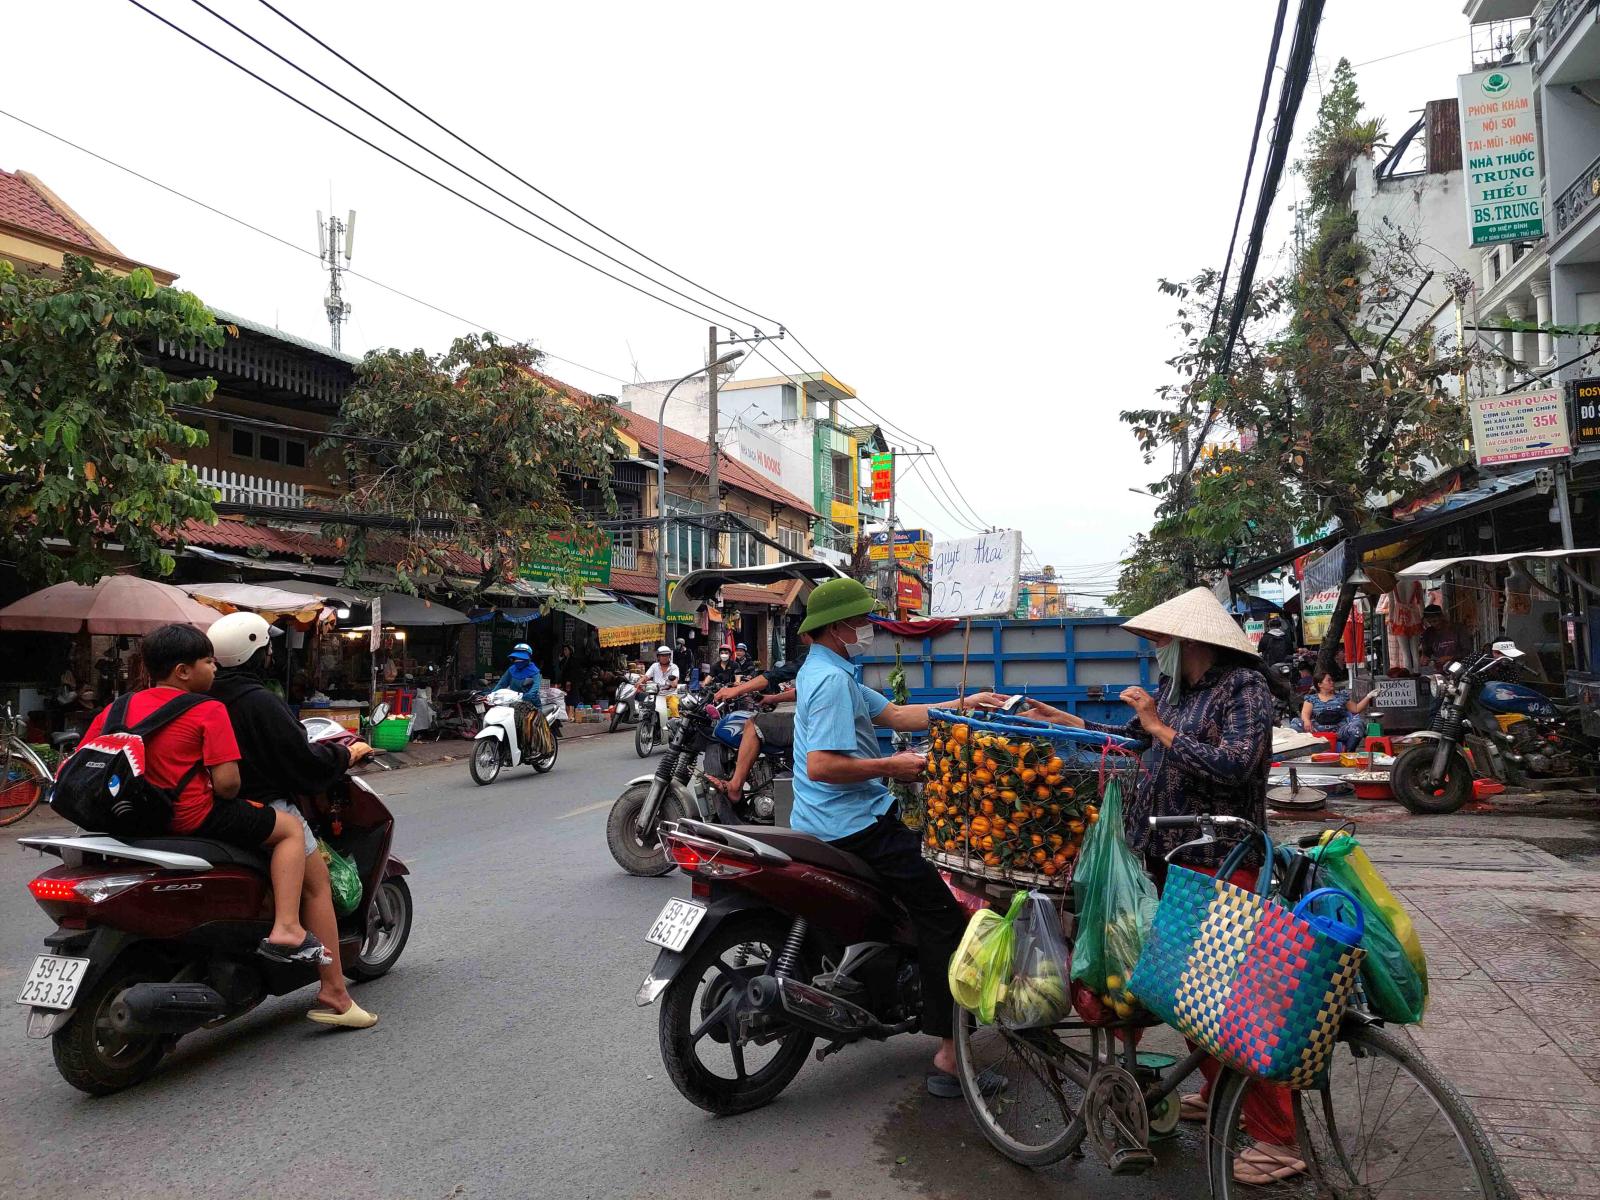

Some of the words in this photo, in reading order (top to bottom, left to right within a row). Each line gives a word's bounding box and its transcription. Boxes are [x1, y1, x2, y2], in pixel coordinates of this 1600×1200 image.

[1470, 155, 1493, 170] NHÀ
[1496, 148, 1535, 166] THUỐC
[1472, 166, 1535, 184] TRUNG
[1482, 181, 1527, 200] HIẾU
[1474, 201, 1539, 223] BS.TRUNG
[1533, 414, 1557, 428] 35K
[152, 883, 202, 892] LEAD
[36, 958, 79, 982] 59-L2
[21, 980, 74, 1006] 253.32
